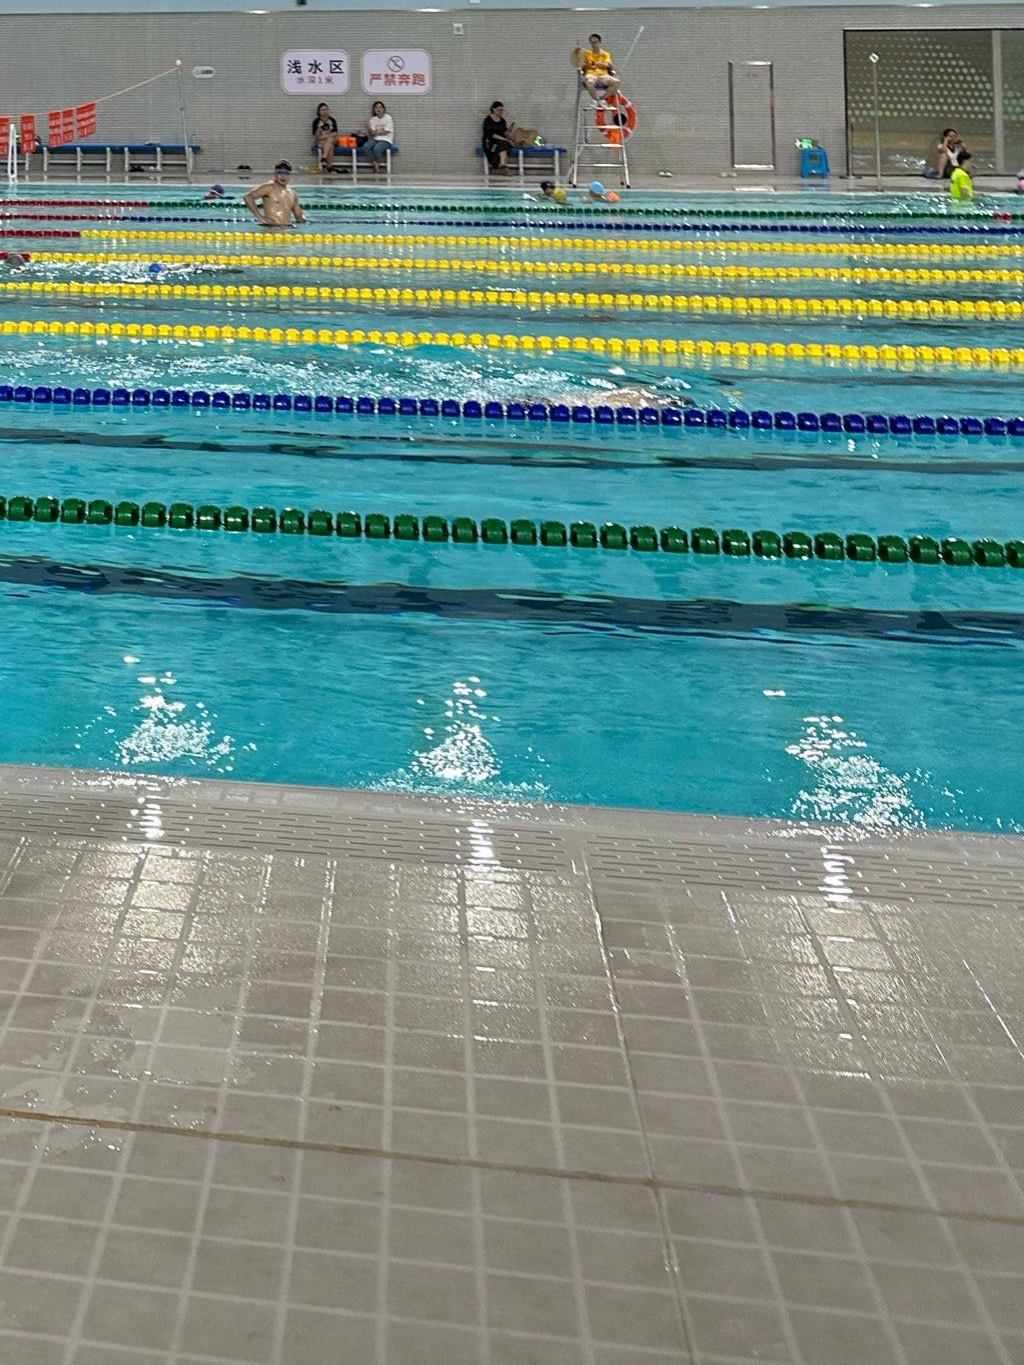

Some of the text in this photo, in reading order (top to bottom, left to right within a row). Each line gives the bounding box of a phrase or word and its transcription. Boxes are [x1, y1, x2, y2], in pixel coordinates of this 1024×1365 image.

[287, 59, 344, 75] 浅水区
[296, 75, 334, 85] 水深1米
[369, 73, 426, 86] 严禁奔跑
